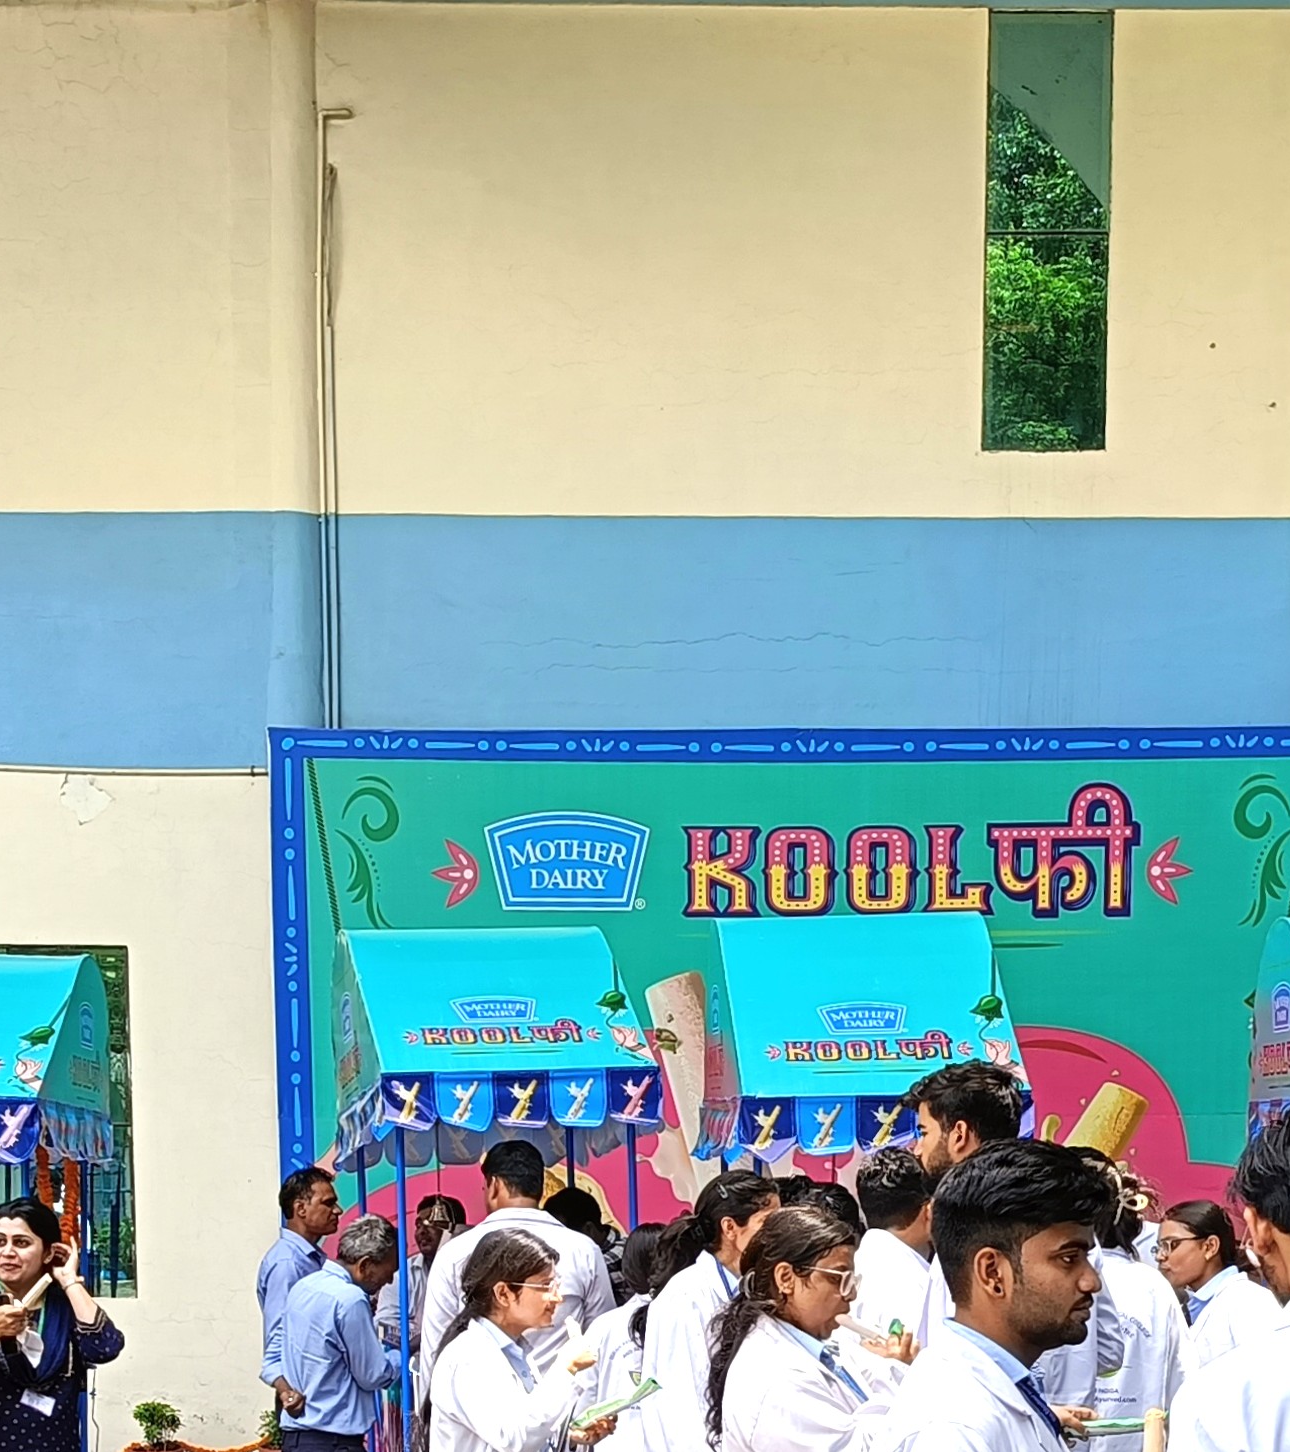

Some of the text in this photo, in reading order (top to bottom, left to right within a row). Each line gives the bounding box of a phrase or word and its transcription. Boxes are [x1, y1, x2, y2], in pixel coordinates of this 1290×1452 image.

[506, 839, 627, 869] MOTHER
[530, 868, 608, 890] DAIRY
[830, 1009, 896, 1022] MOTHER
[843, 1019, 886, 1028] DAIRY
